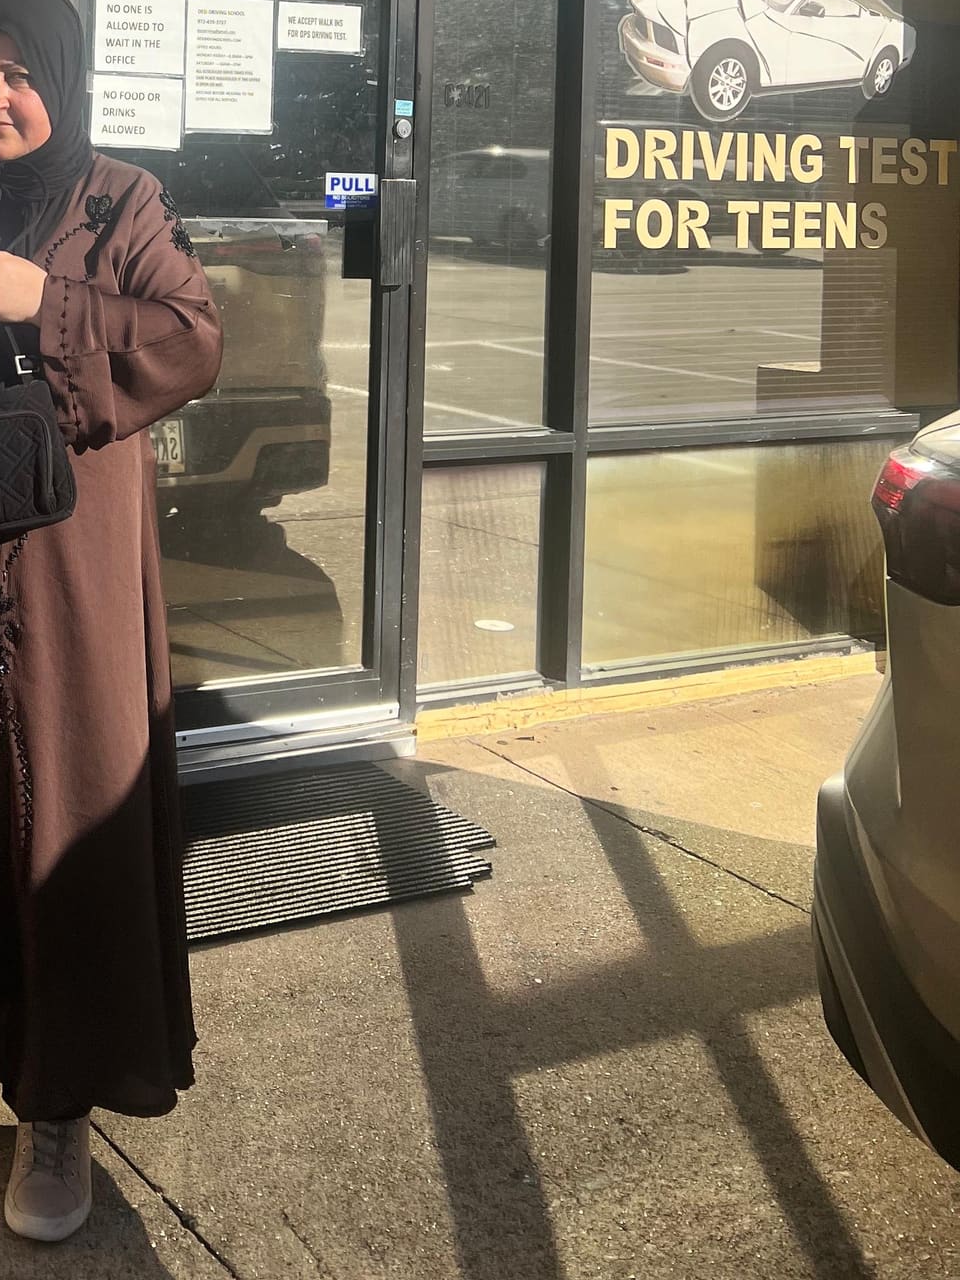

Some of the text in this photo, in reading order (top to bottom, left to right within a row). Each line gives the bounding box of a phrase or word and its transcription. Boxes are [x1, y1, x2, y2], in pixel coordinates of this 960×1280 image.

[106, 3, 153, 15] NO ONE IS
[106, 21, 164, 32] ALLOWED TO
[287, 16, 296, 25] WE
[297, 16, 318, 26] ACCEPT
[287, 29, 299, 38] FOR
[311, 31, 333, 40] DRIVING
[105, 38, 161, 49] WAIT IN THE
[105, 55, 136, 65] OFFICE
[103, 90, 161, 102] NO FOOD OR
[102, 107, 136, 118] DRINKS
[101, 124, 146, 135] ALLOWED
[605, 128, 958, 186] DRIVING TEST
[330, 177, 374, 192] PULL
[603, 198, 889, 250] FOR TEENS
